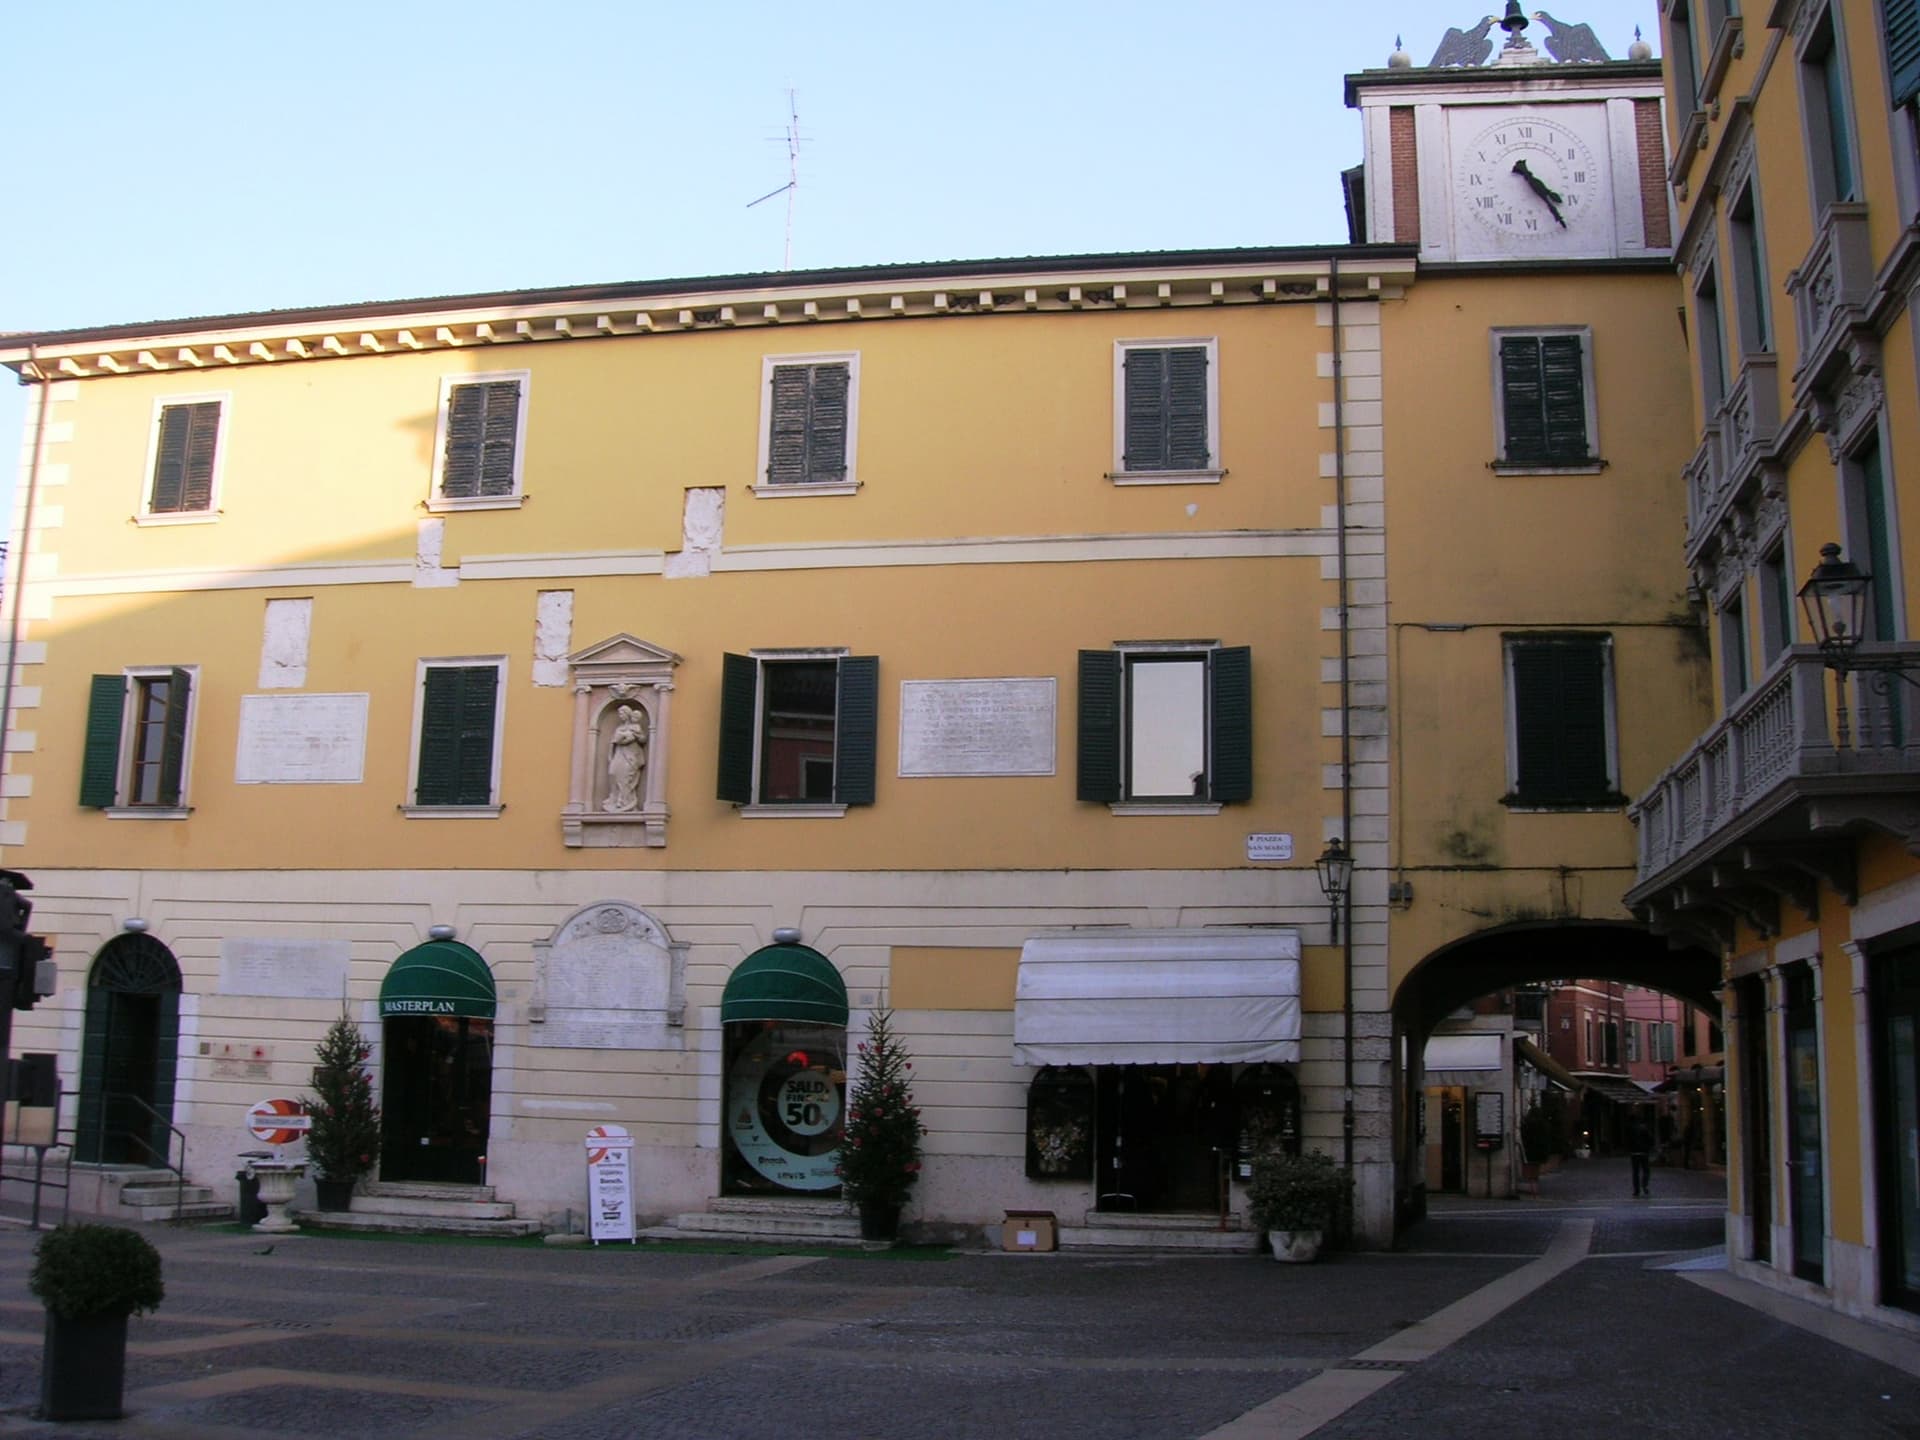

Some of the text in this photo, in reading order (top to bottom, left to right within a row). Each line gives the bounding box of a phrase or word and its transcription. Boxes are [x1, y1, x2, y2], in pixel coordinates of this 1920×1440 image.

[1518, 127, 1532, 138] XII
[1495, 133, 1506, 145] XI
[1478, 151, 1487, 162] X
[1567, 148, 1575, 160] II
[1470, 174, 1482, 185] IX
[1574, 171, 1585, 183] III
[1476, 196, 1493, 208] VIII
[1567, 194, 1578, 206] IV
[1497, 213, 1512, 225] VII
[1525, 219, 1537, 231] VI
[384, 1000, 455, 1012] MASTERPLAN
